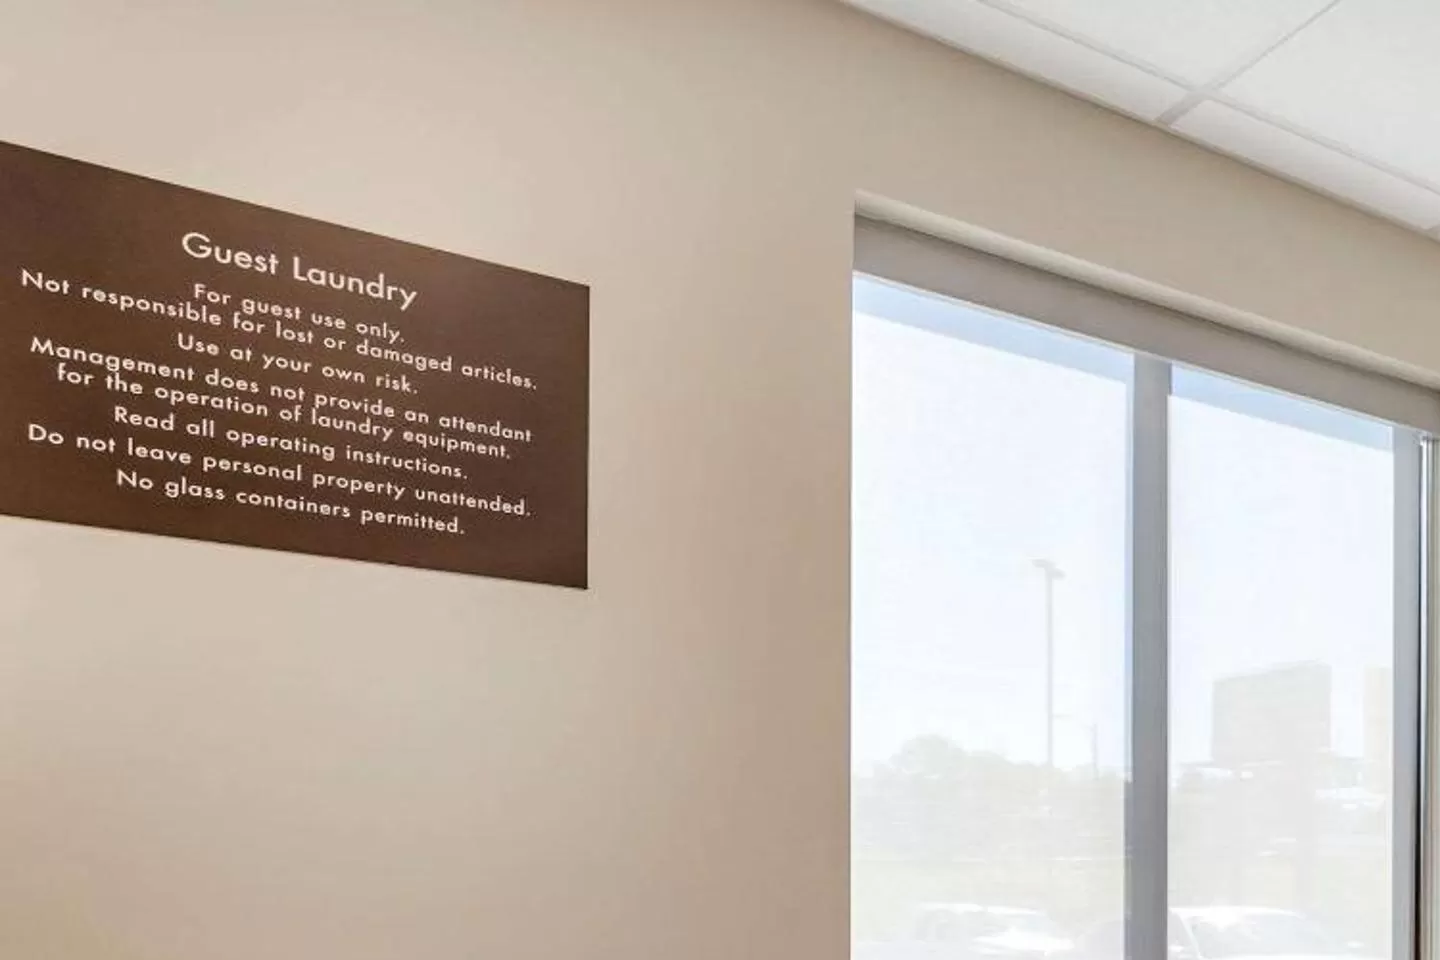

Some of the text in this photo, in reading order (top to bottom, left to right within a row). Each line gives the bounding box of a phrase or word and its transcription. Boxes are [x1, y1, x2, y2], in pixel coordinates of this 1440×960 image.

[181, 231, 418, 312] Guest Laundry
[21, 268, 537, 390] Not responsible for lost or damaged articles.
[194, 283, 405, 344] For guest use only.
[30, 336, 532, 443] Management does not provide an attendant
[177, 331, 418, 395] Use at your own risk.
[57, 362, 511, 460] for the operation of laundry equipment.
[114, 405, 468, 481] Read all operating instructions.
[28, 423, 532, 518] Do not leave personal property unattended.
[116, 468, 466, 536] No glass containers permitted.
